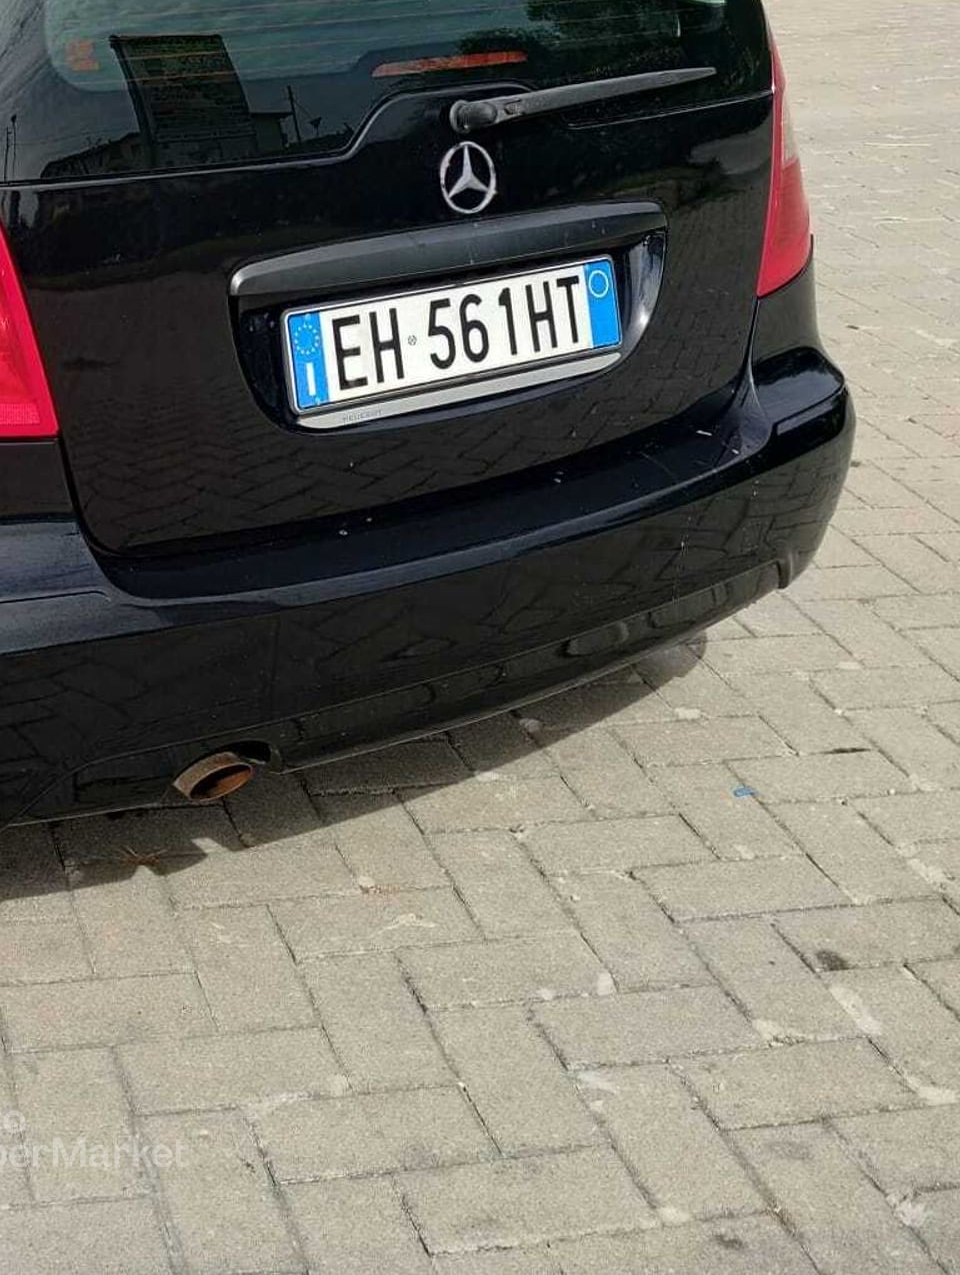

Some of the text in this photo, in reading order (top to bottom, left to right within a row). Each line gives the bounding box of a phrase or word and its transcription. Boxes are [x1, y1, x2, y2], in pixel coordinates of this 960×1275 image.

[331, 274, 581, 392] EH 561HT
[305, 362, 318, 397] I
